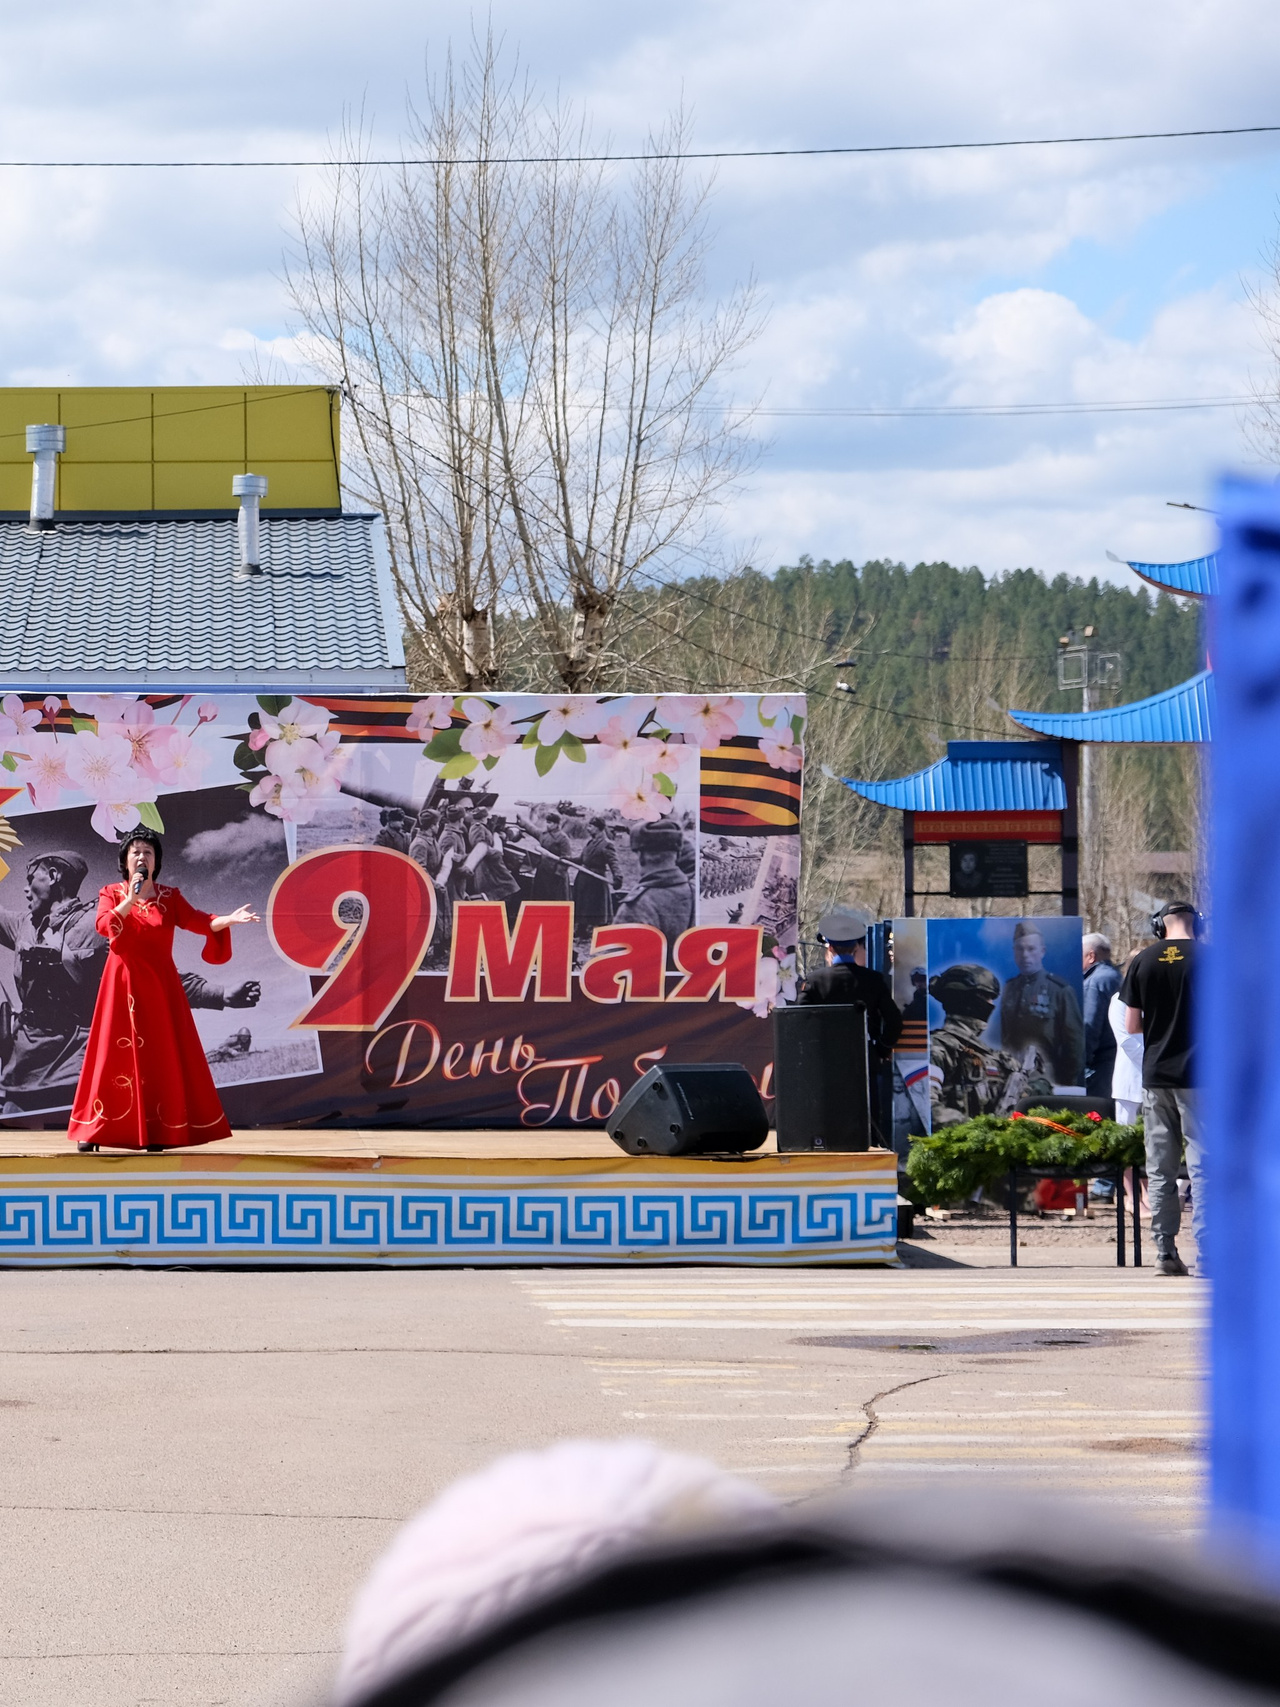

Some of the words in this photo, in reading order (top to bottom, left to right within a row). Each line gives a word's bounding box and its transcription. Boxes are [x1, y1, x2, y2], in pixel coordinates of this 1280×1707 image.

[266, 844, 437, 1031] 9
[444, 900, 764, 1003] Мая
[365, 1019, 547, 1088] День
